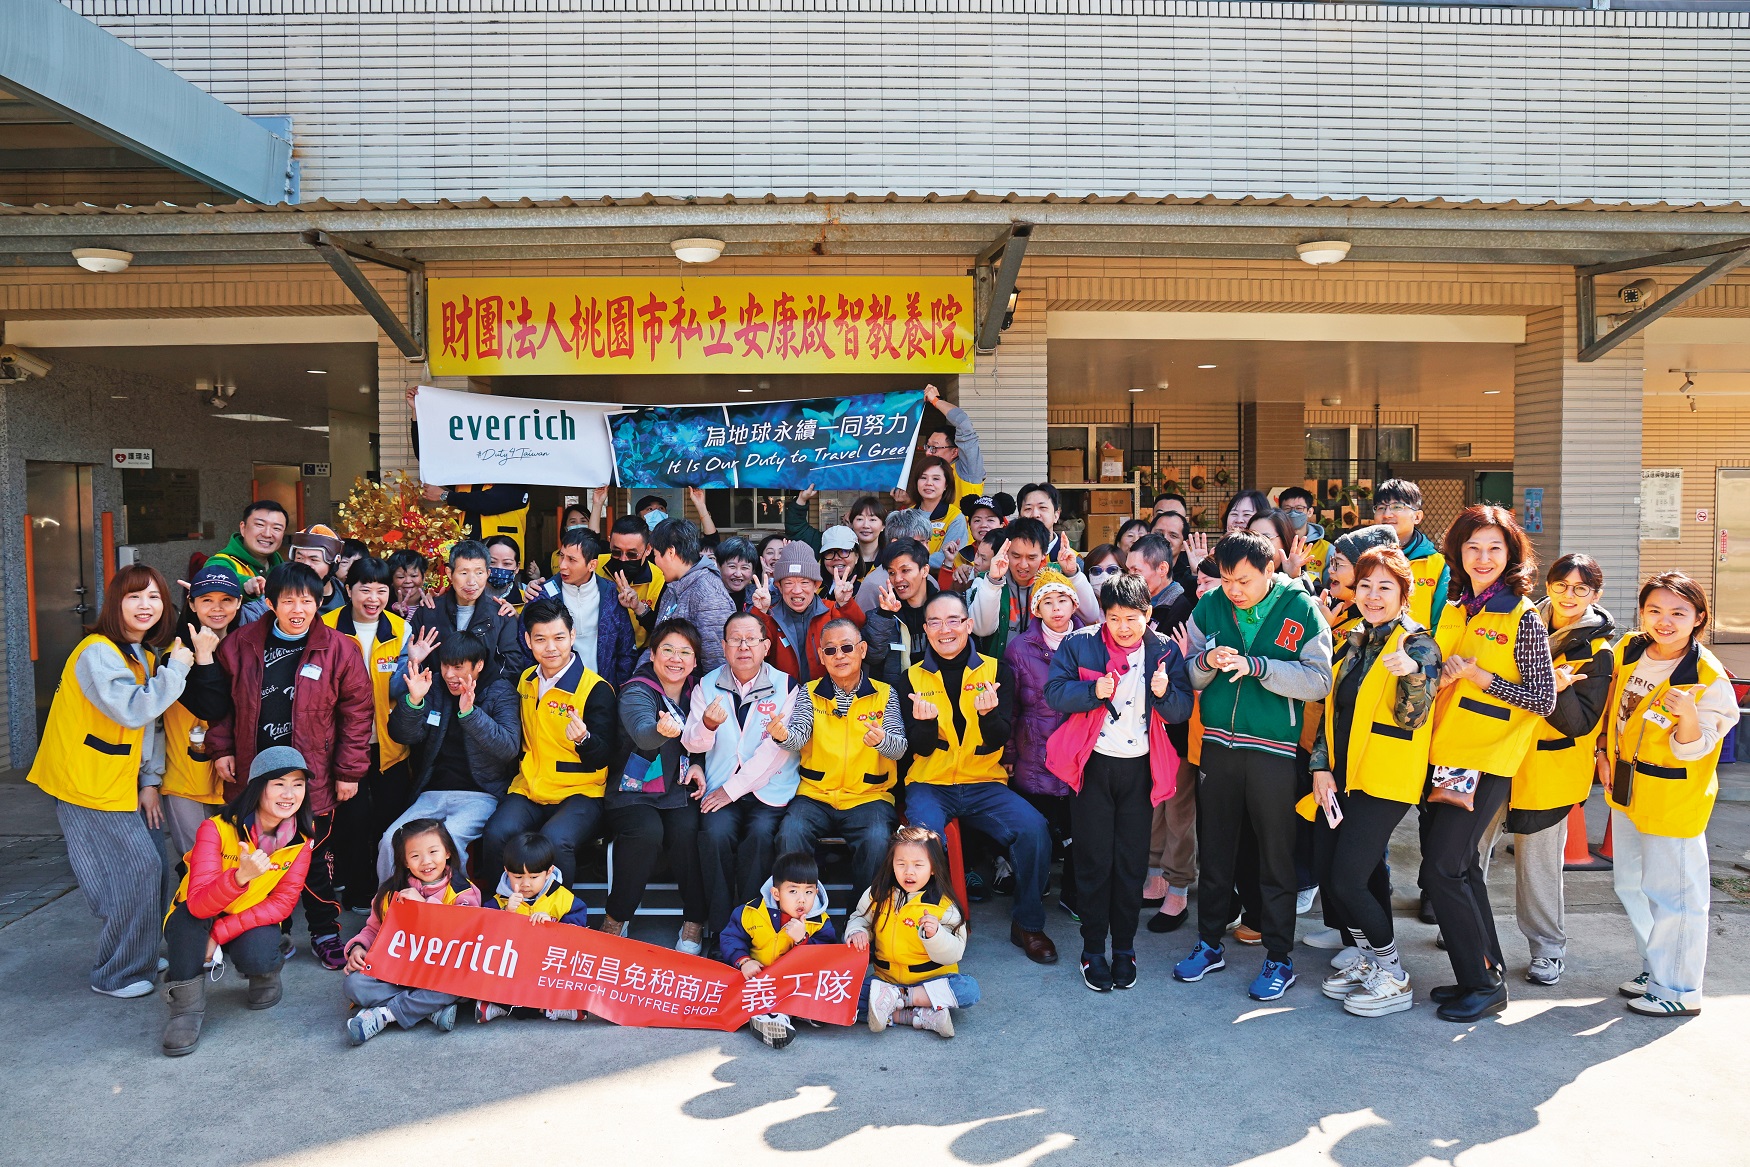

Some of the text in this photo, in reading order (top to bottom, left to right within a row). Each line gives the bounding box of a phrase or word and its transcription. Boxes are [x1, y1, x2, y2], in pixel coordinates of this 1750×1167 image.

[449, 408, 576, 441] everrich
[704, 412, 908, 448] 為地球永續一同努力
[667, 460, 681, 475] It
[686, 459, 700, 473] Is
[705, 457, 739, 472] Our
[745, 451, 786, 473] Duty
[790, 449, 808, 464] to
[814, 444, 864, 462] Travel
[1274, 617, 1305, 653] R
[387, 929, 519, 979] everrich
[541, 945, 729, 1004] 昇恆昌免稅商店
[741, 969, 853, 1013] 義工隊
[537, 976, 718, 1016] EVERRICH DUTYFREE SHOP
